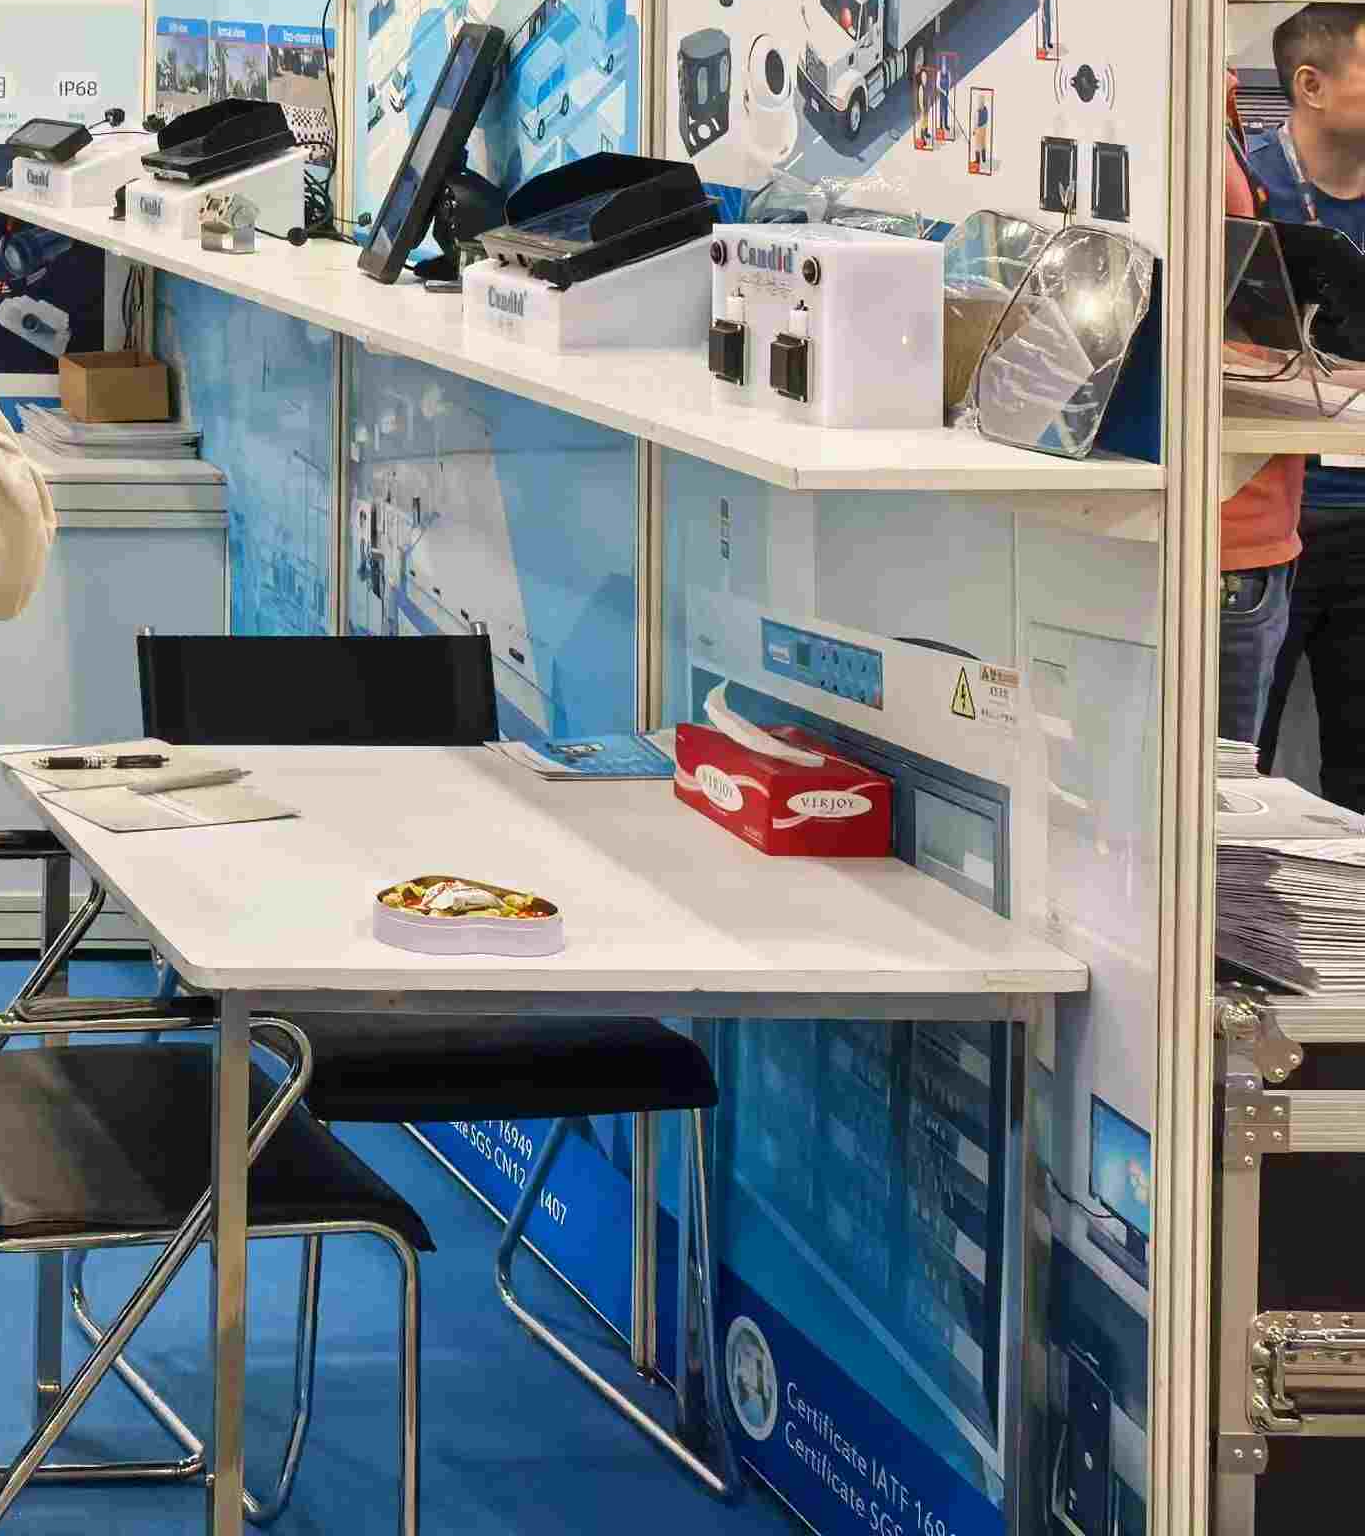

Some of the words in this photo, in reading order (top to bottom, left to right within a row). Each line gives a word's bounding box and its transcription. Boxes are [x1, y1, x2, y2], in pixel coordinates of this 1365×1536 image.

[58, 80, 98, 96] IP68
[469, 1124, 492, 1161] SGS
[784, 1420, 870, 1520] Certificate
[786, 1382, 868, 1478] Certificate
[871, 1457, 910, 1513] IATF
